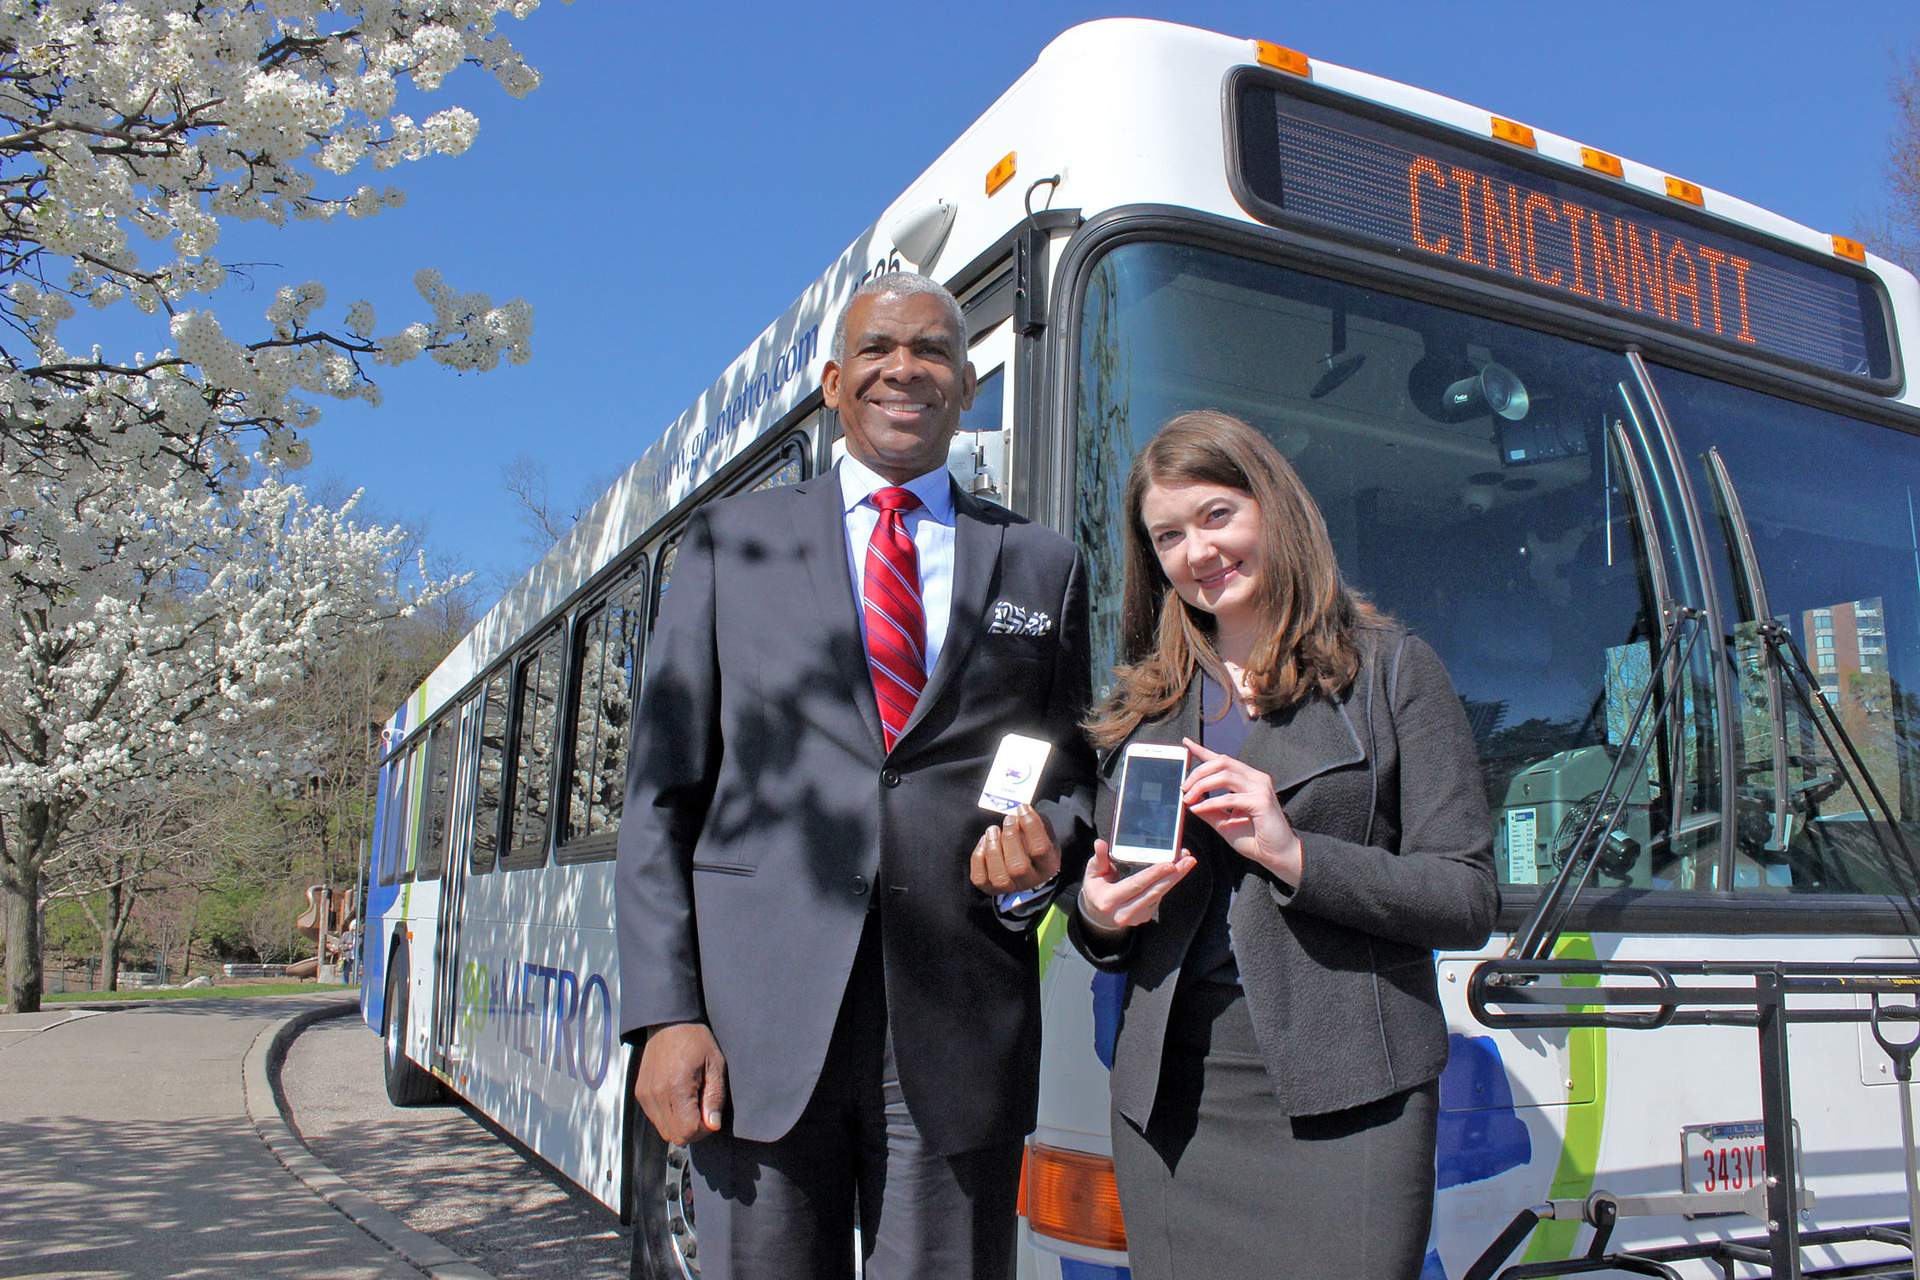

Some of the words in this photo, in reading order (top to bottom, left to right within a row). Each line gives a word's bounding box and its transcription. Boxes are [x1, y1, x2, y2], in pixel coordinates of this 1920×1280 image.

[1408, 157, 1757, 344] CINCINNATI
[652, 323, 819, 500] www.go-metro.com
[1713, 1122, 1764, 1137] GILLI
